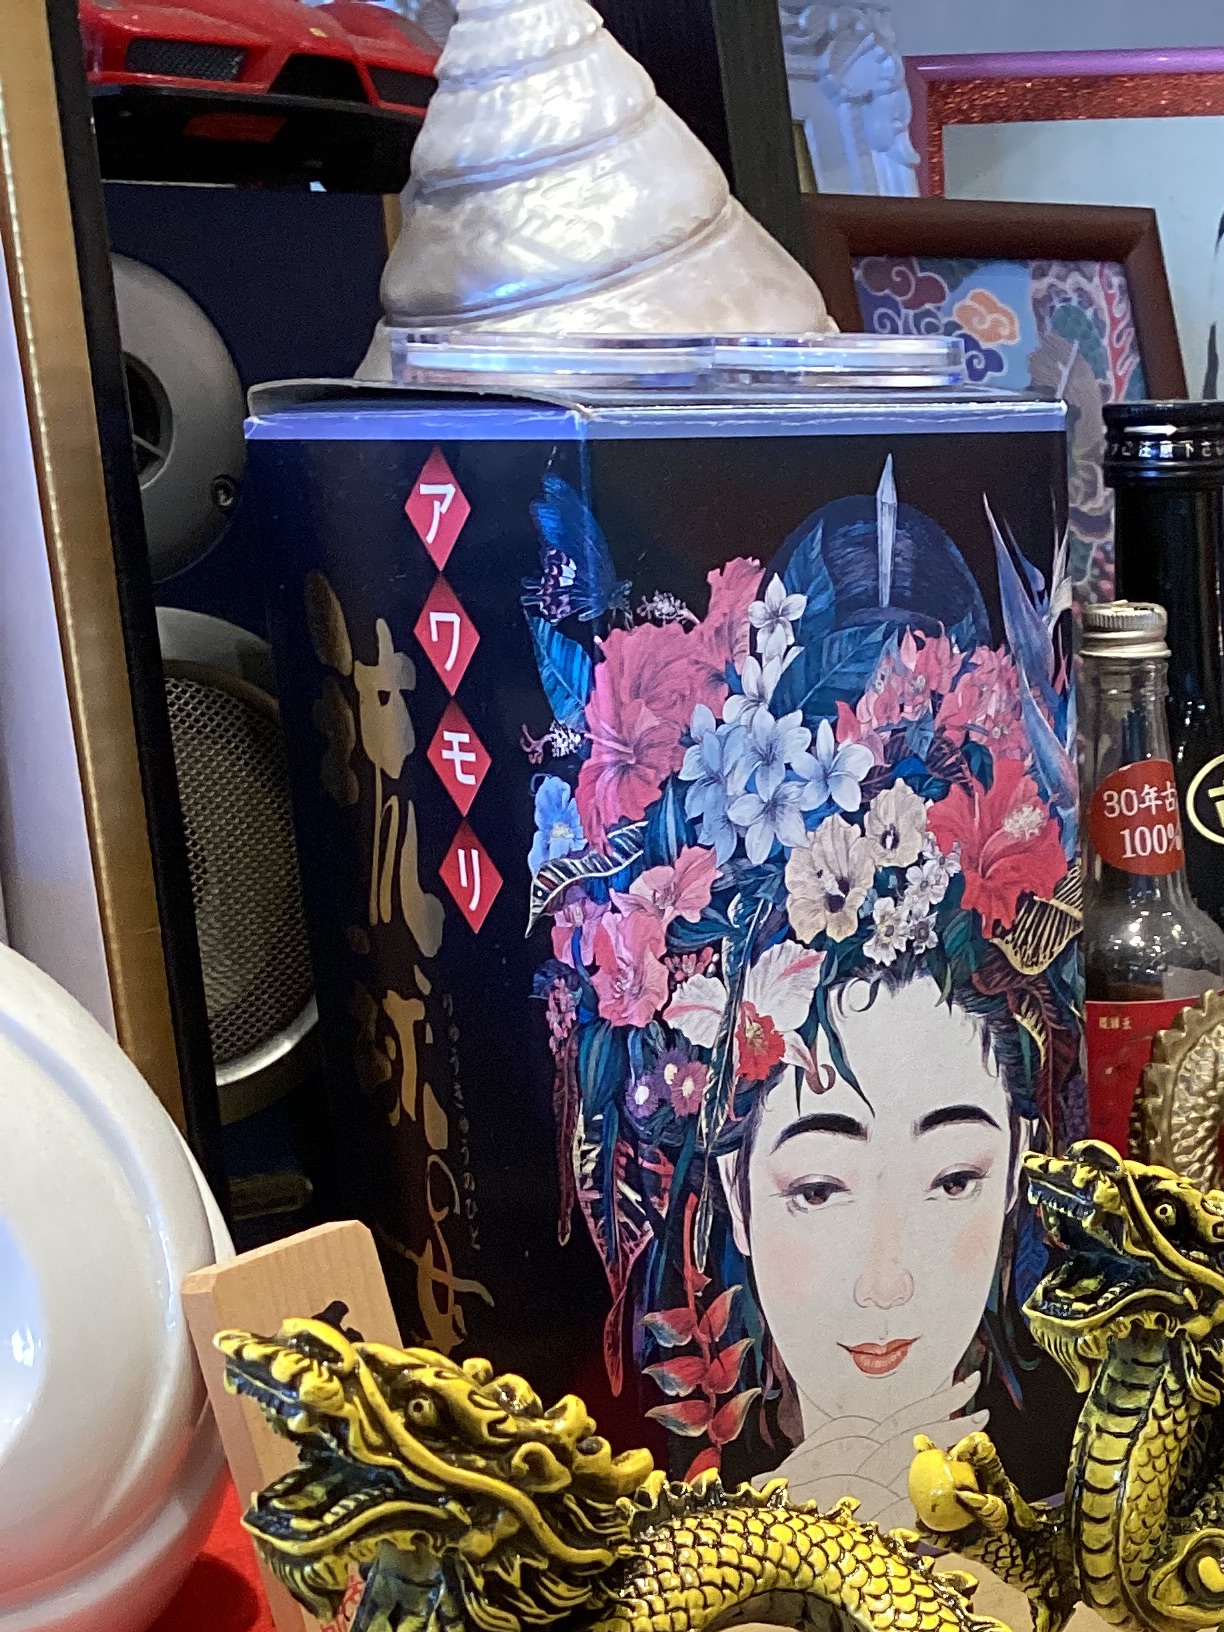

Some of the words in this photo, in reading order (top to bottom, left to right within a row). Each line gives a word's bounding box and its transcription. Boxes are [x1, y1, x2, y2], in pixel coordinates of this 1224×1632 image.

[419, 484, 482, 912] アワモリ
[1119, 821, 1182, 859] 100%
